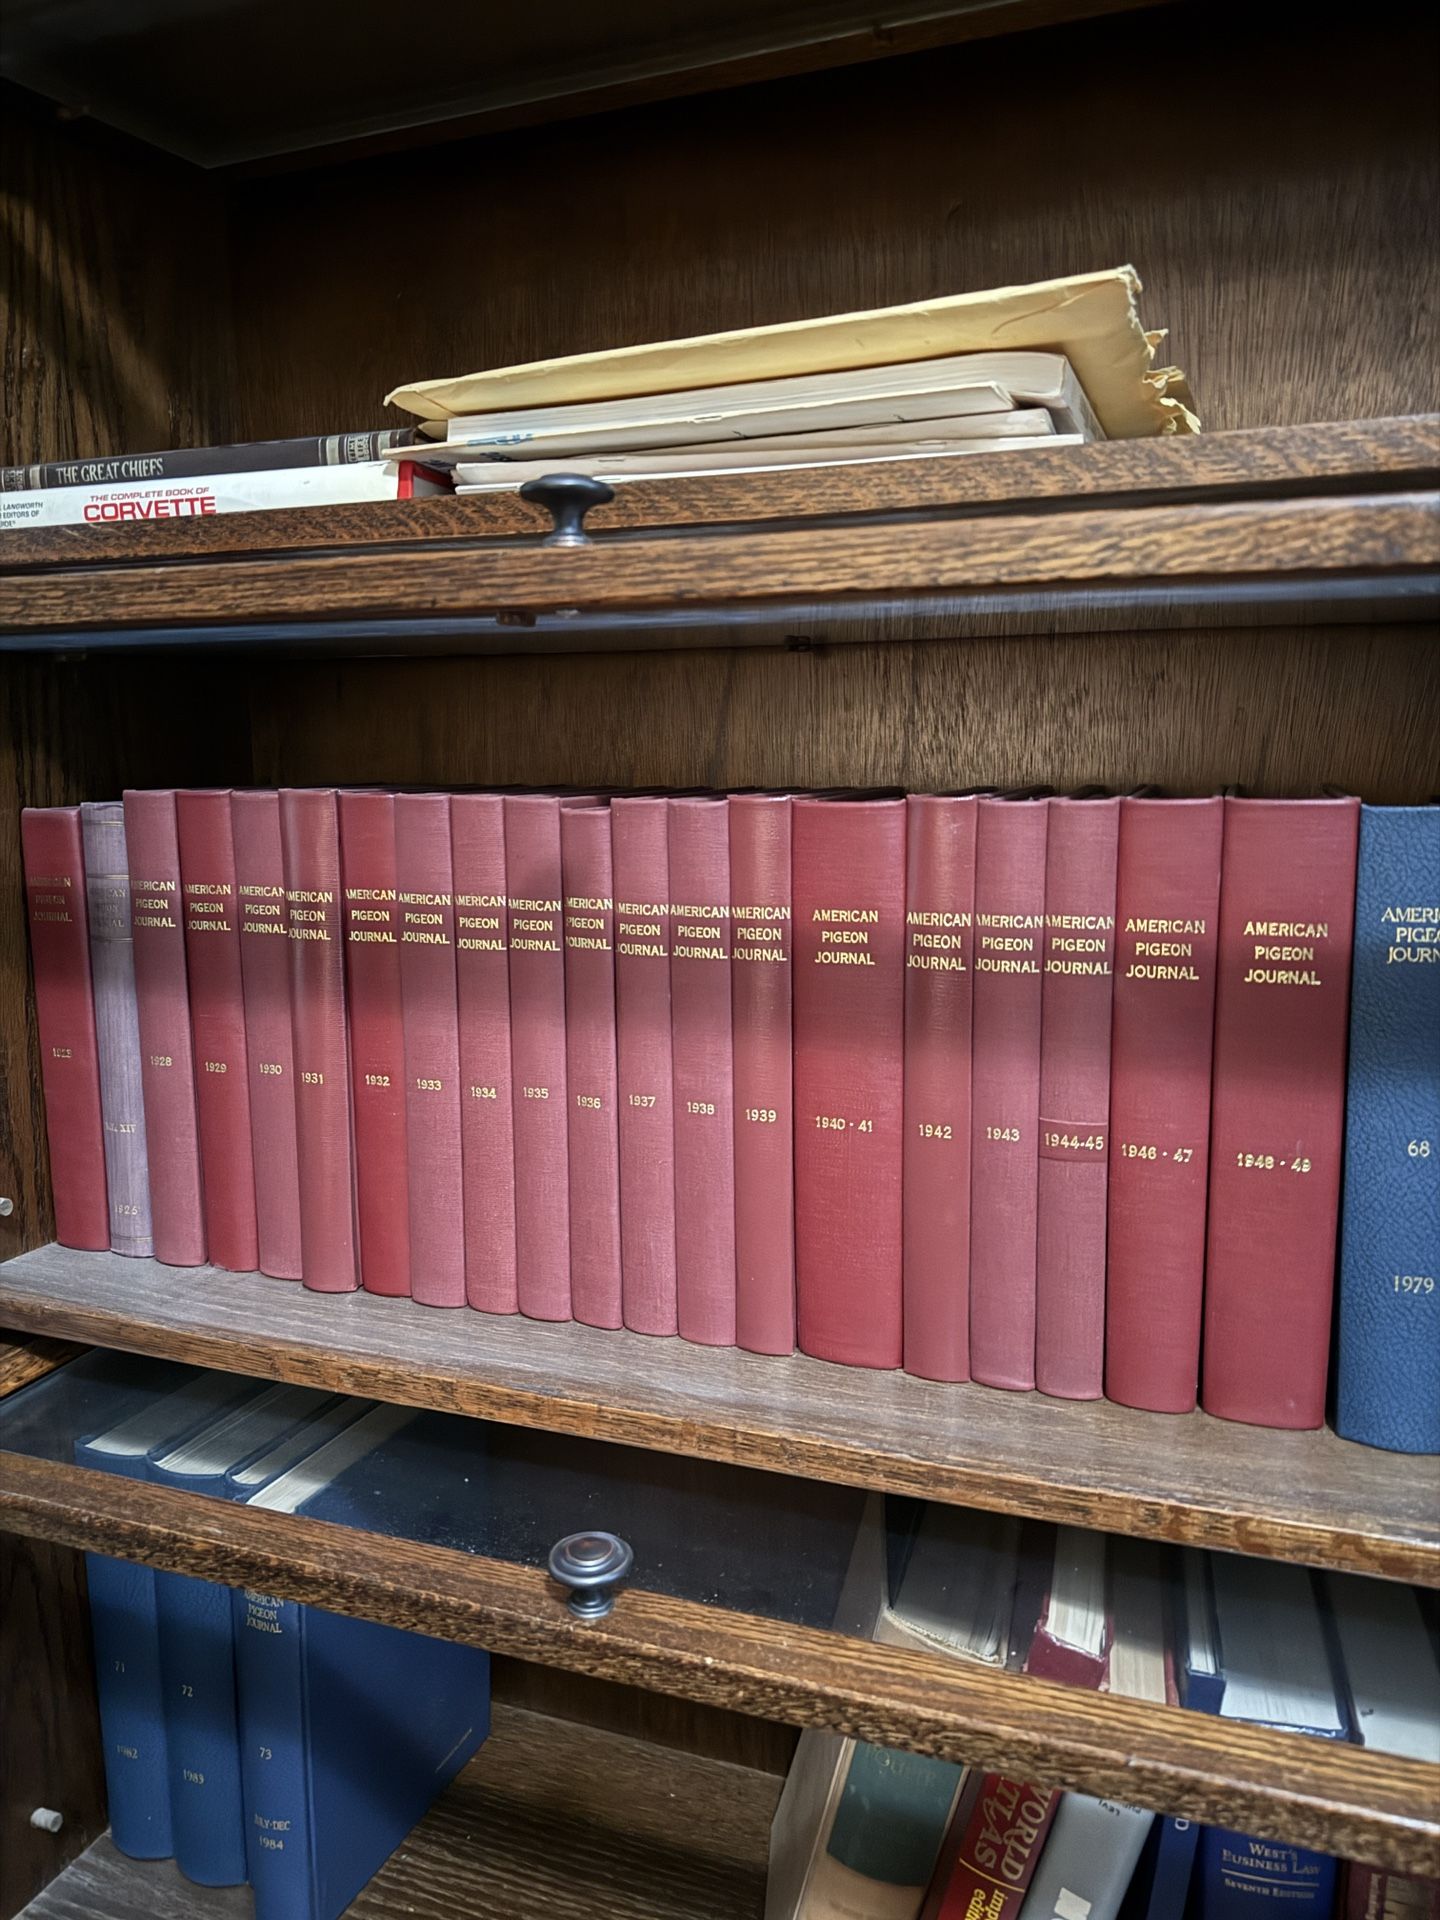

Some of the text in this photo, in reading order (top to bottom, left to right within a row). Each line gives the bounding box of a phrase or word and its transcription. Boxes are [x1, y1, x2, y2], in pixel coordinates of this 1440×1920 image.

[55, 457, 164, 485] THE GREAT CHIEFS
[90, 486, 210, 502] THE COMPLETE BOOK OF
[3, 511, 30, 519] EDITORS
[84, 496, 216, 522] CORVETTE
[184, 883, 231, 895] AMERICAN
[239, 885, 285, 897] AMERICAN
[136, 898, 168, 909] PIGEON
[398, 892, 451, 906] AMERICAN
[508, 899, 561, 912] AMERICAN
[565, 897, 613, 910] MERICAN
[190, 902, 224, 913] PIGEON
[245, 903, 280, 915] PIGEON
[617, 902, 669, 916] MERICAN
[670, 904, 729, 919] AMERICAN
[134, 916, 176, 928] JOURNAL
[290, 909, 326, 922] PIGEON
[352, 910, 390, 921] PIGEON
[405, 912, 443, 925] PIGEON
[459, 916, 499, 929] PIGEON
[566, 916, 604, 929] PIGEON
[812, 909, 879, 923] AMERICAN
[906, 911, 972, 927] AMERICAN
[1044, 914, 1115, 931] AMERICAN
[187, 919, 231, 931] JOURNAL
[242, 922, 287, 934] JOURNAL
[513, 919, 553, 931] PIGEON
[619, 923, 661, 936] PIGEON
[678, 925, 720, 939] PIGEON
[1125, 919, 1206, 935] AMERICAN
[1243, 921, 1328, 938] AMERICAN
[288, 927, 331, 941] JOURNAL
[349, 931, 397, 943] JOURNAL
[401, 931, 450, 945] JOURNAL
[737, 927, 782, 941] PIGEON
[822, 931, 868, 944] PIGEON
[913, 933, 961, 949] PIGEON
[457, 938, 507, 951] JOURNAL
[509, 938, 560, 951] JOURNAL
[981, 936, 1033, 951] PIGEON
[1052, 936, 1106, 953] PIGEON
[1135, 942, 1192, 958] PIGEON
[673, 945, 728, 960] JOURNAL
[732, 947, 787, 962] JOURNAL
[814, 952, 875, 966] JOURNAL
[1254, 945, 1314, 962] PIGEON
[906, 955, 966, 971] JOURNAL
[975, 958, 1040, 974] JOURNAL
[1044, 959, 1113, 976] JOURNAL
[1126, 964, 1200, 981] JOURNAL
[1243, 968, 1321, 986] JOURNAL
[151, 1055, 173, 1067] 1928
[204, 1062, 227, 1073] 1929
[259, 1063, 282, 1075] 1930
[301, 1072, 324, 1085] 1931
[365, 1074, 391, 1087] 1932
[416, 1078, 442, 1091] 1933
[471, 1086, 496, 1099] 1934
[523, 1086, 549, 1099] 1935
[576, 1095, 601, 1109] 1936
[629, 1094, 656, 1108] 1937
[687, 1101, 715, 1116] 1938
[745, 1108, 777, 1122] 1939
[918, 1124, 953, 1140] 1942
[986, 1126, 1020, 1143] 1943
[1121, 1143, 1157, 1161] 1946
[1407, 1140, 1431, 1158] 68
[1393, 1275, 1435, 1295] 1979
[244, 1589, 284, 1608] MERICAN
[114, 1660, 126, 1673] 71
[181, 1684, 194, 1698] 72
[259, 1747, 272, 1760] 73
[258, 1835, 285, 1851] 1984
